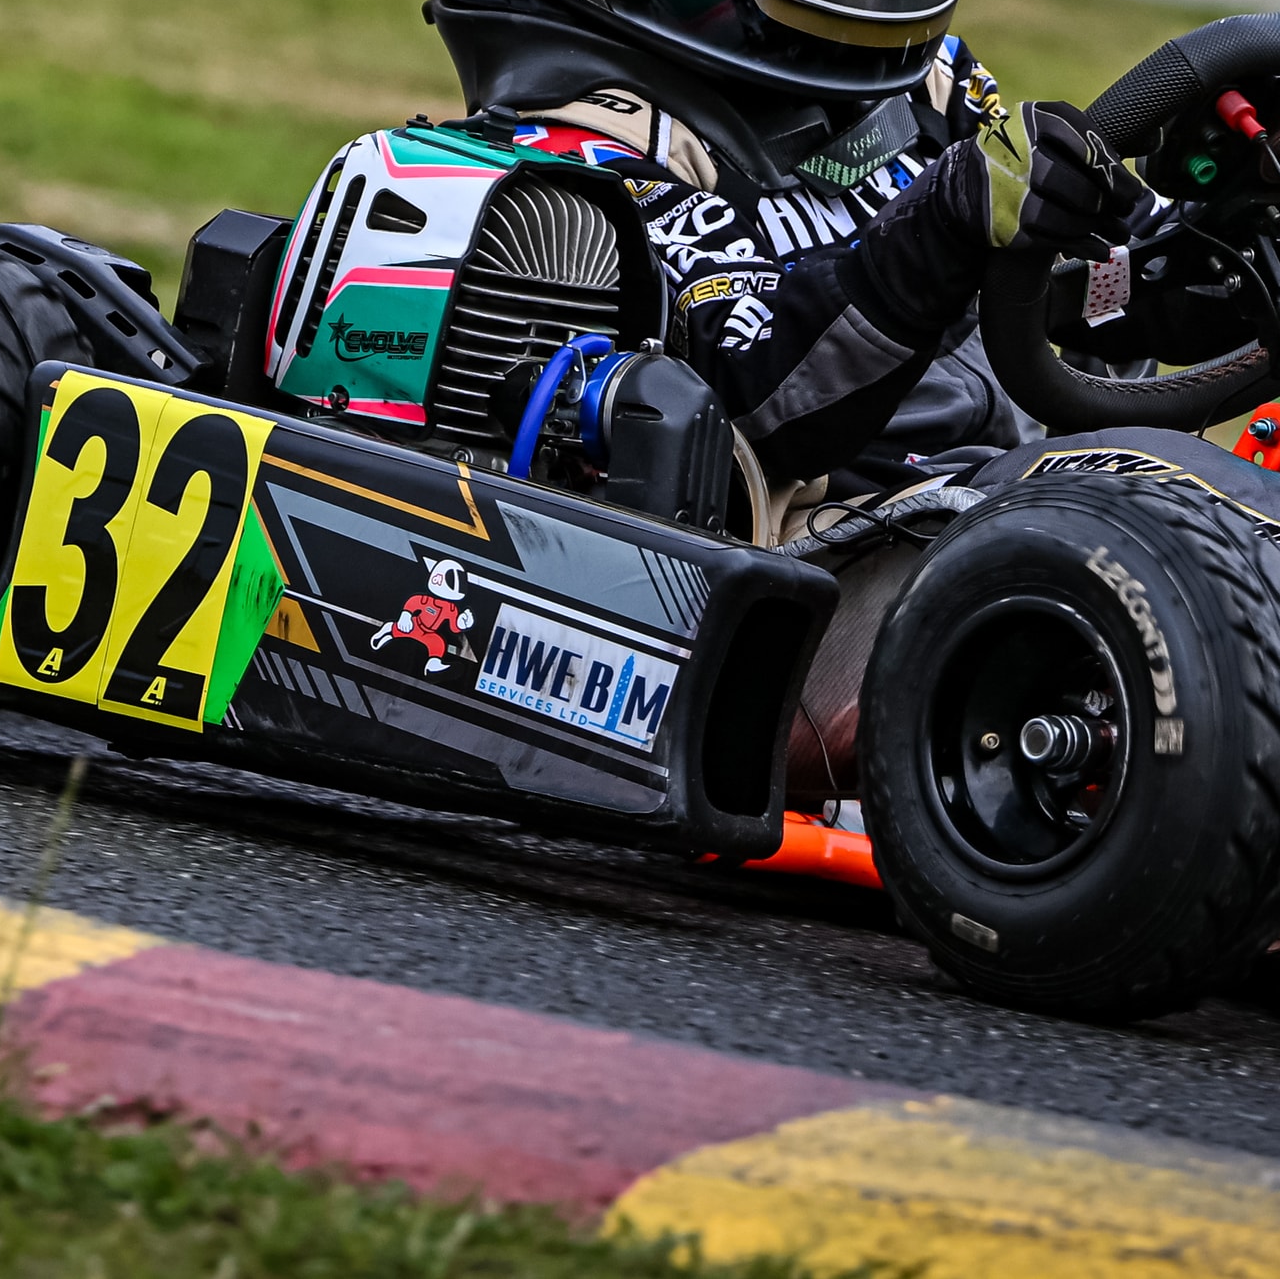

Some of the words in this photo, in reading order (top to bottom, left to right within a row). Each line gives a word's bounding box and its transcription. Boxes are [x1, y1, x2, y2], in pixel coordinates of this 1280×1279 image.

[647, 195, 735, 246] KC
[345, 330, 429, 355] EVOLVE
[11, 387, 248, 721] 32
[483, 626, 583, 702] HWE
[478, 678, 553, 713] SERVICES
[559, 707, 588, 726] LTD
